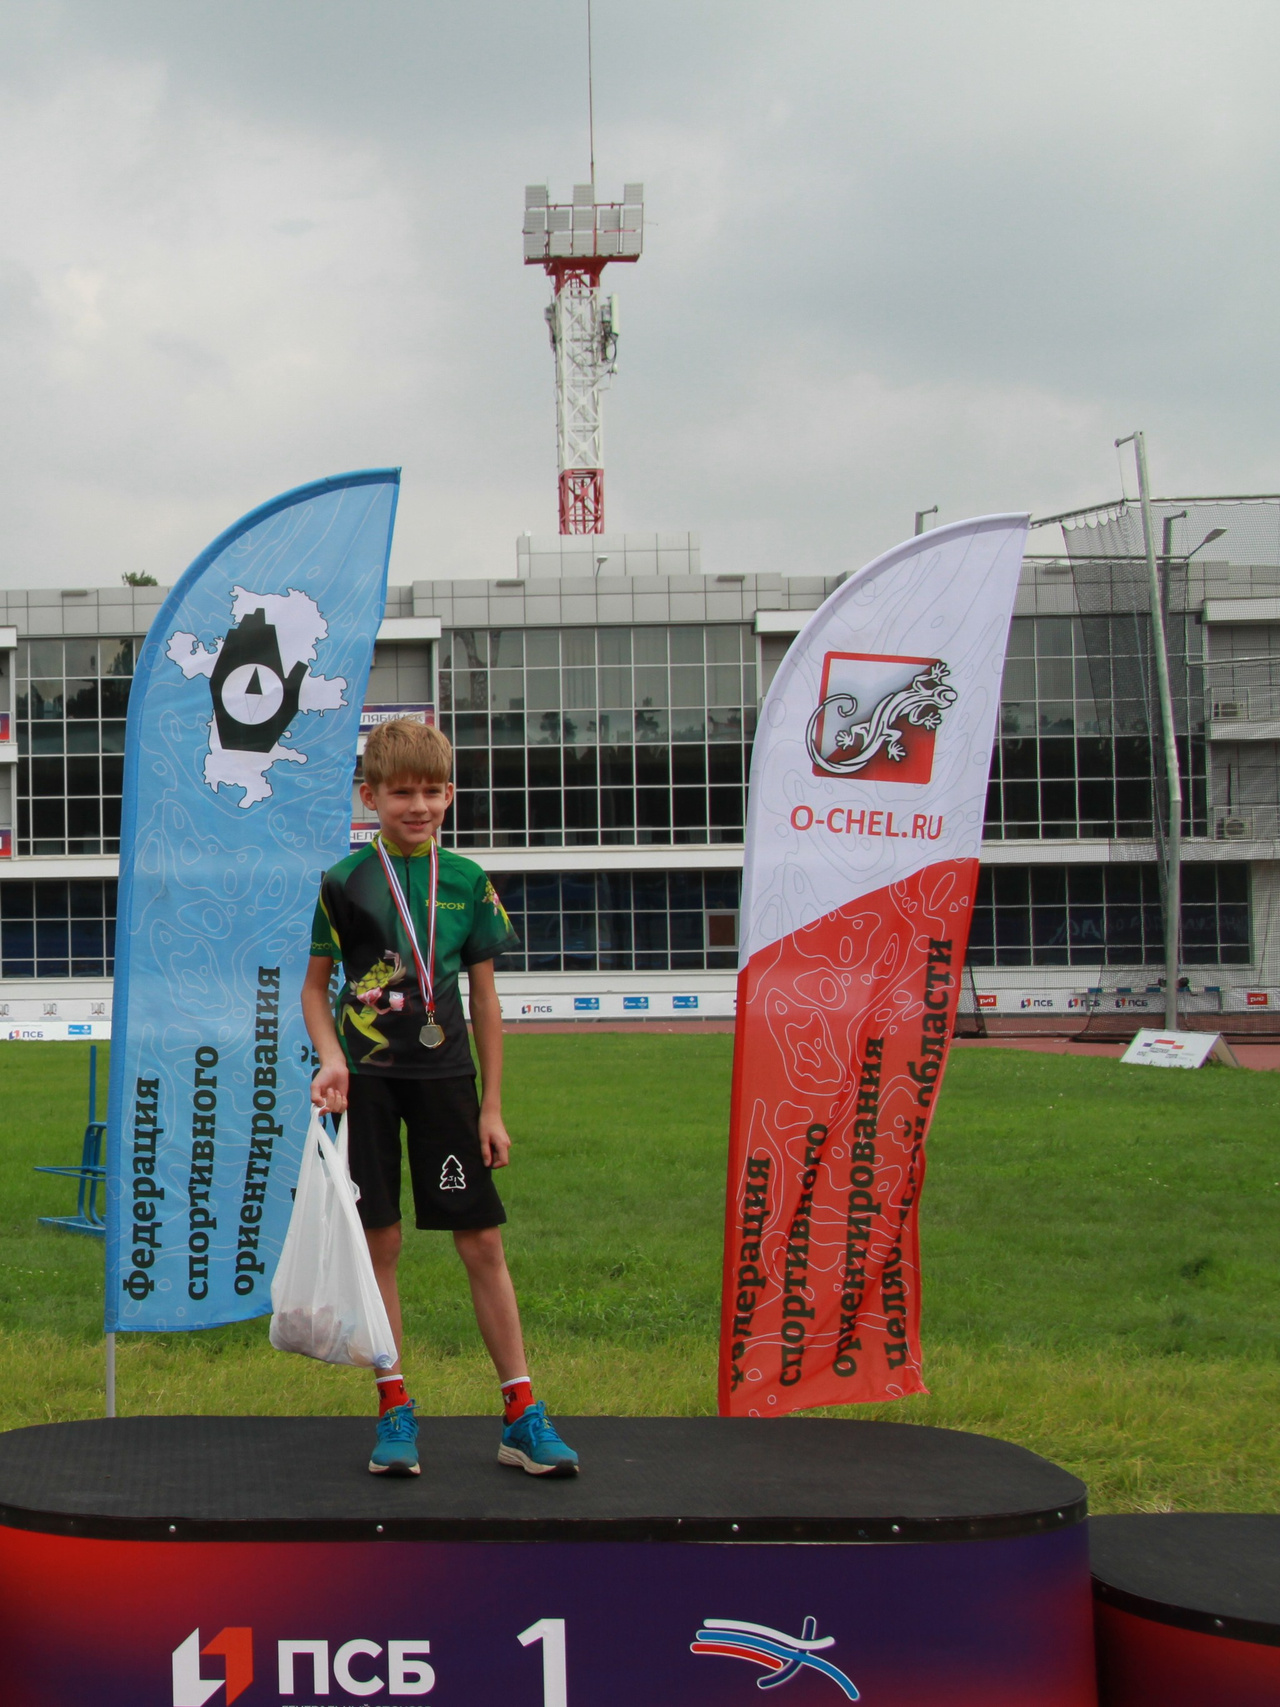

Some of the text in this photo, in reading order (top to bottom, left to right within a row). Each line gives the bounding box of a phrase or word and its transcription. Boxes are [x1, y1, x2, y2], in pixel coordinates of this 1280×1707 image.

[790, 805, 943, 840] O-CHEL.RU
[533, 1005, 553, 1013] ПСБ
[1033, 999, 1054, 1007] ПСБ
[22, 1030, 44, 1038] ПСБ
[234, 966, 283, 1295] ориентирования
[123, 1077, 164, 1301] Федерация
[188, 1045, 218, 1301] спортивного
[277, 1639, 436, 1697] ПСБ
[517, 1618, 566, 1707] 1
